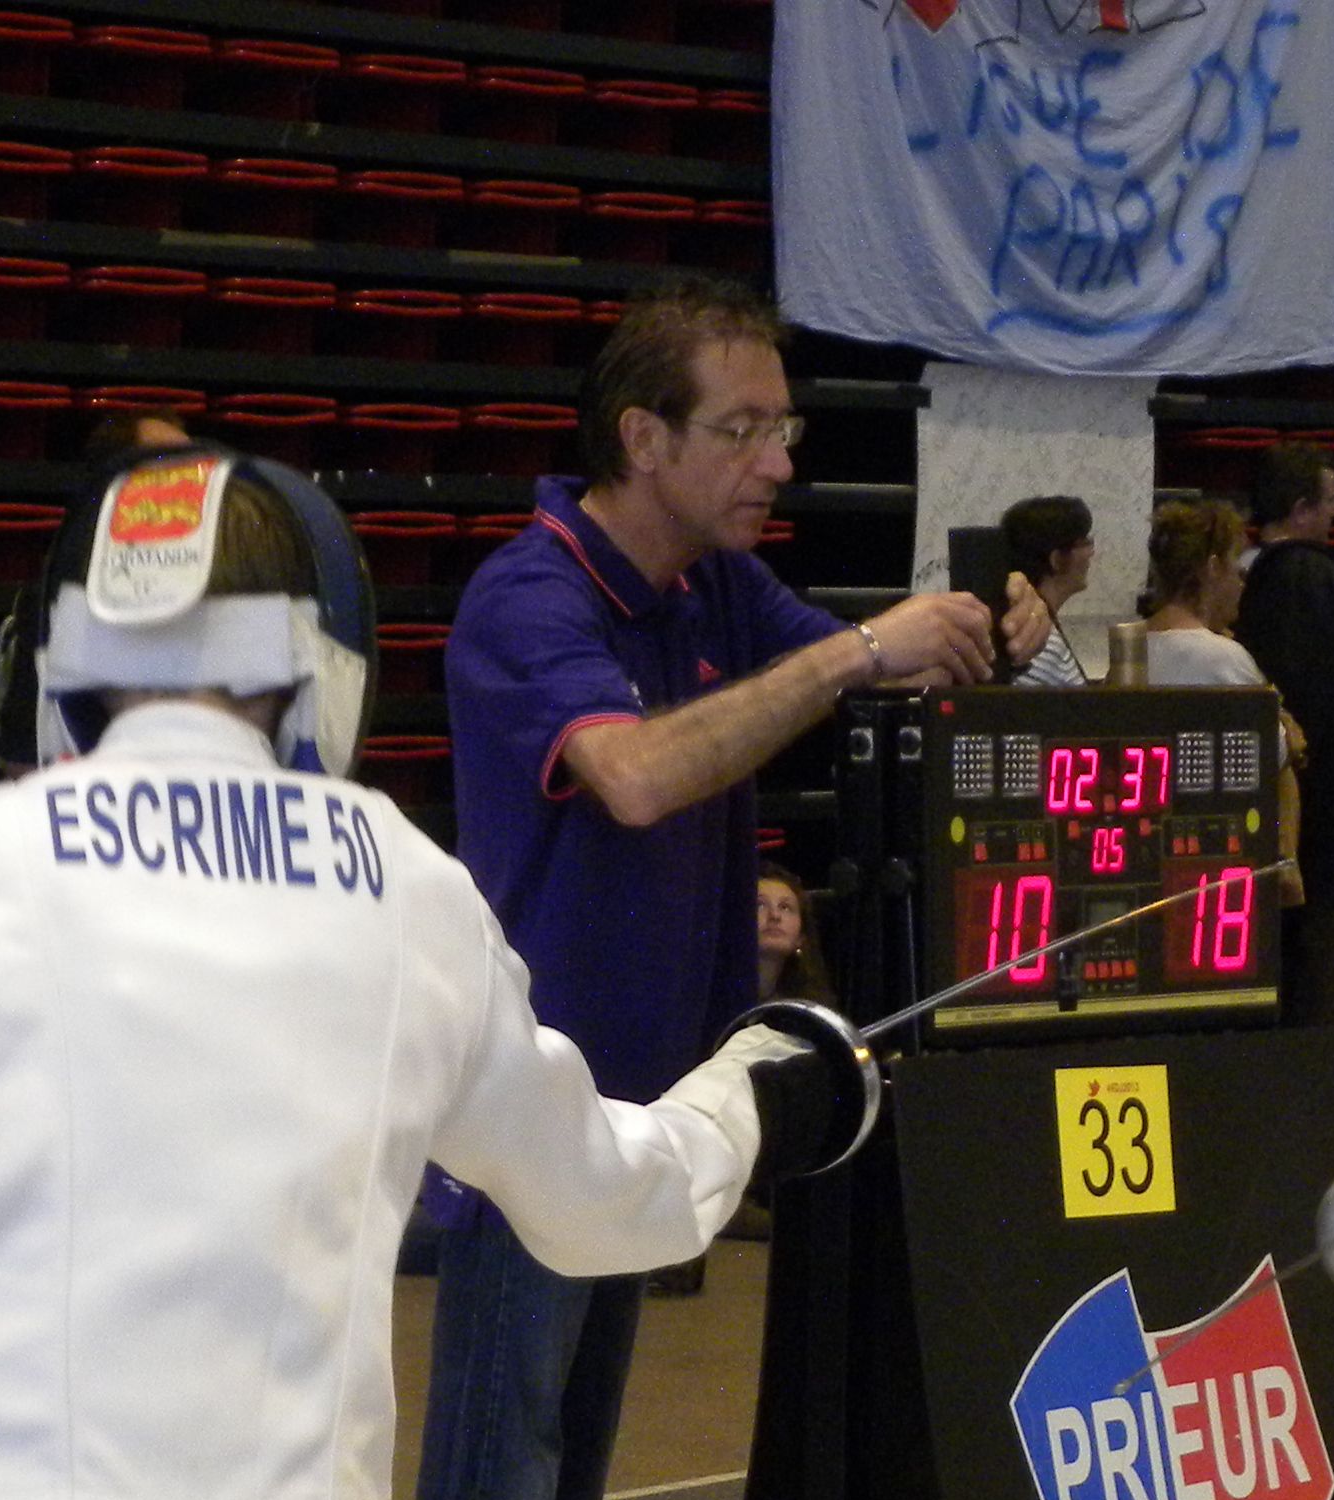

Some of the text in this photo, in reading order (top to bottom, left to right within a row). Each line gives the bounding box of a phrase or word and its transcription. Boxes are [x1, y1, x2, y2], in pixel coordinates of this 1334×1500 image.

[1186, 14, 1300, 160] DE
[989, 163, 1243, 298] PARIS
[45, 777, 386, 900] ESCRIME 50
[1092, 827, 1126, 873] 05
[986, 865, 1255, 983] 10 18
[1078, 1097, 1155, 1197] 33
